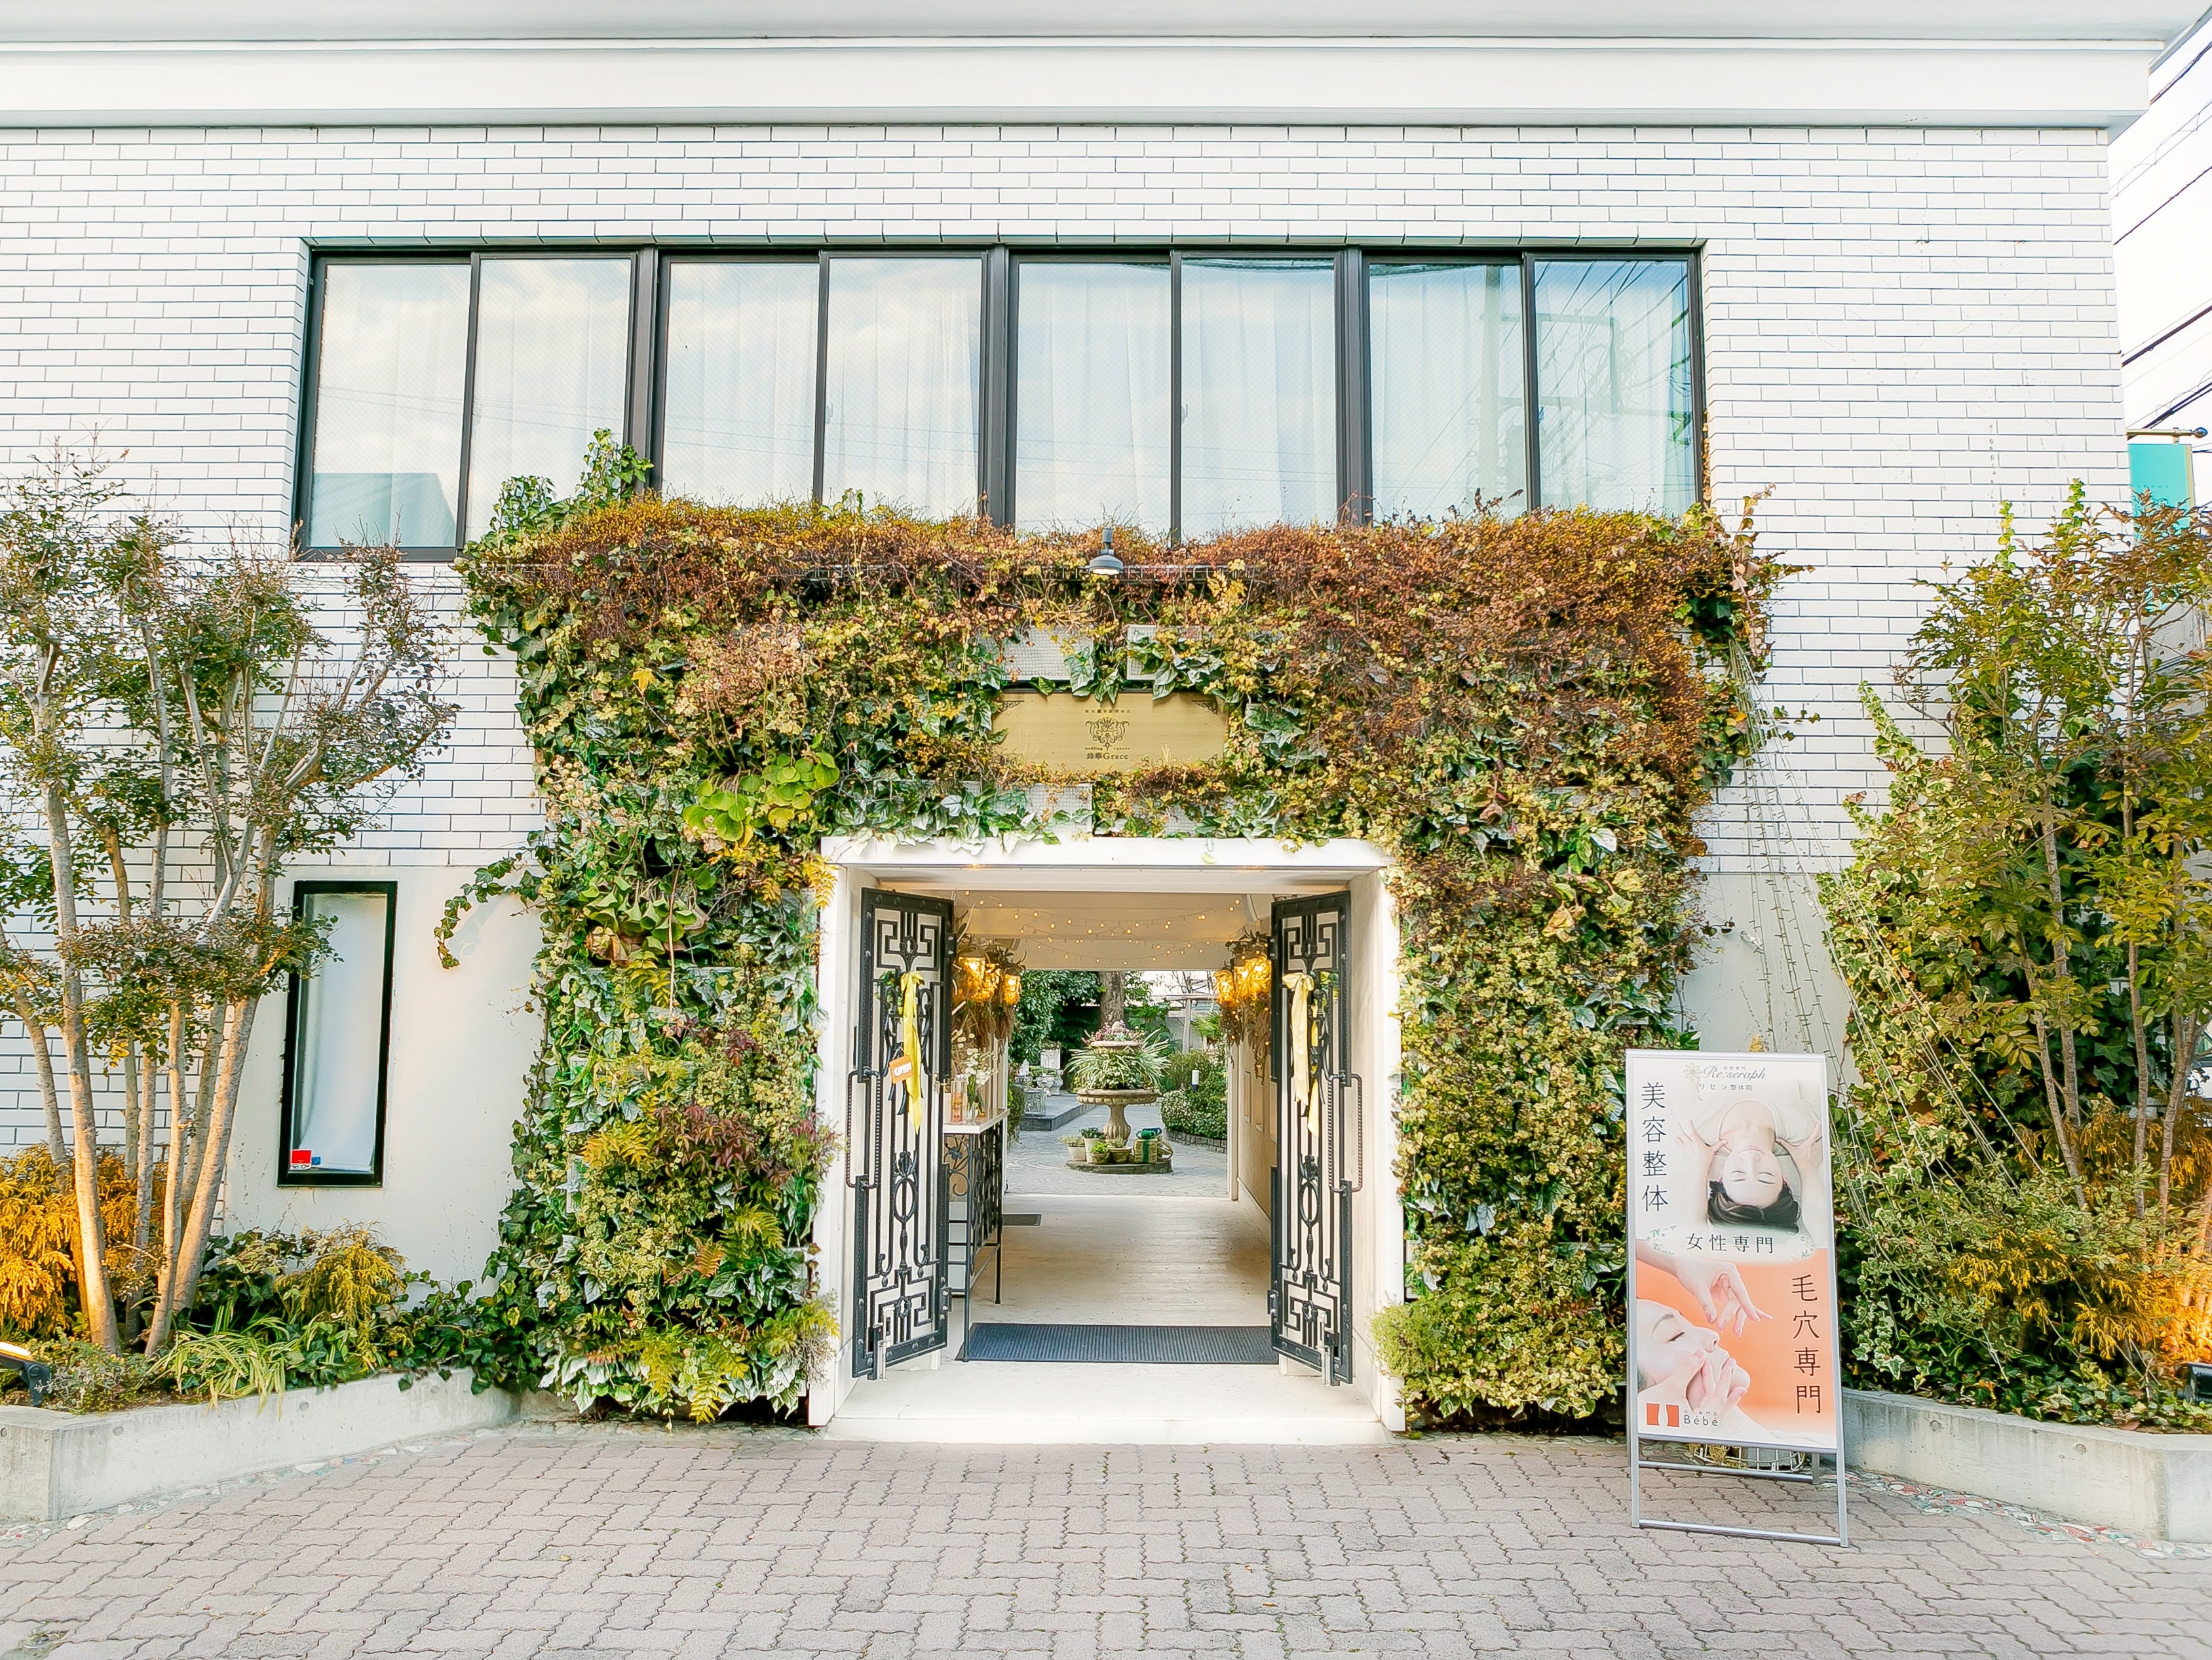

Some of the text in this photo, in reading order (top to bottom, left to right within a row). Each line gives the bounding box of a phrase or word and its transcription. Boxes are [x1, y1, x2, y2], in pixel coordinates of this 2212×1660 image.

[894, 1062, 913, 1077] OPEN
[1702, 1064, 1766, 1081] Re:seraph
[1641, 1081, 1669, 1213] 美容整体
[1685, 1232, 1774, 1254] 女性専門
[1791, 1274, 1821, 1415] 毛穴専門
[1684, 1414, 1718, 1427] Bébé
